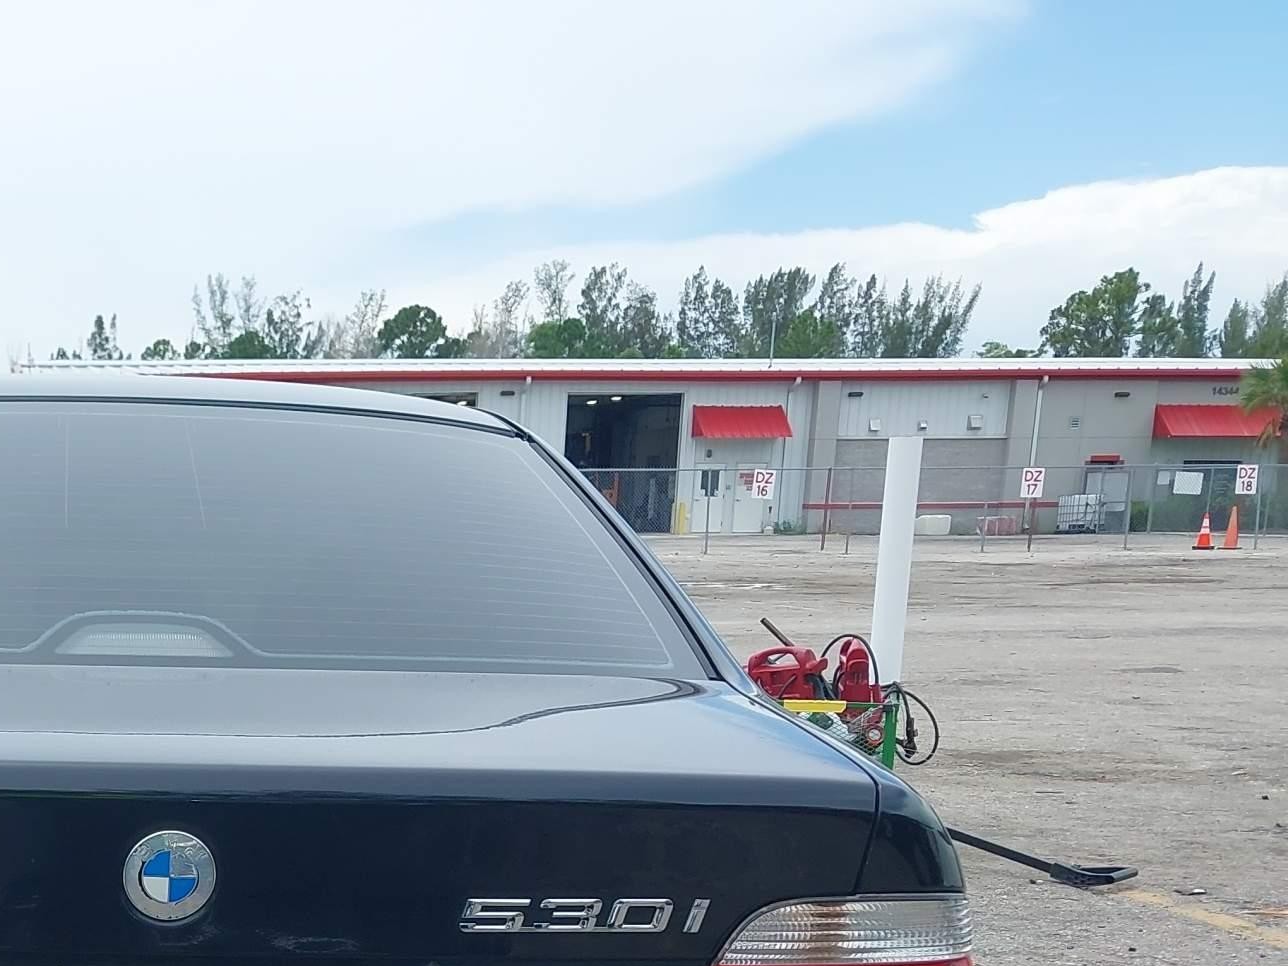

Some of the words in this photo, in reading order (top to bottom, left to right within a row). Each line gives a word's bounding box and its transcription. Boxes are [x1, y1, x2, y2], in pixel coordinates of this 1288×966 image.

[756, 471, 774, 484] DZ
[1024, 470, 1043, 482] DZ
[1239, 467, 1256, 479] DZ
[757, 485, 768, 497] 16
[1027, 483, 1038, 495] 17
[1241, 480, 1253, 492] 18
